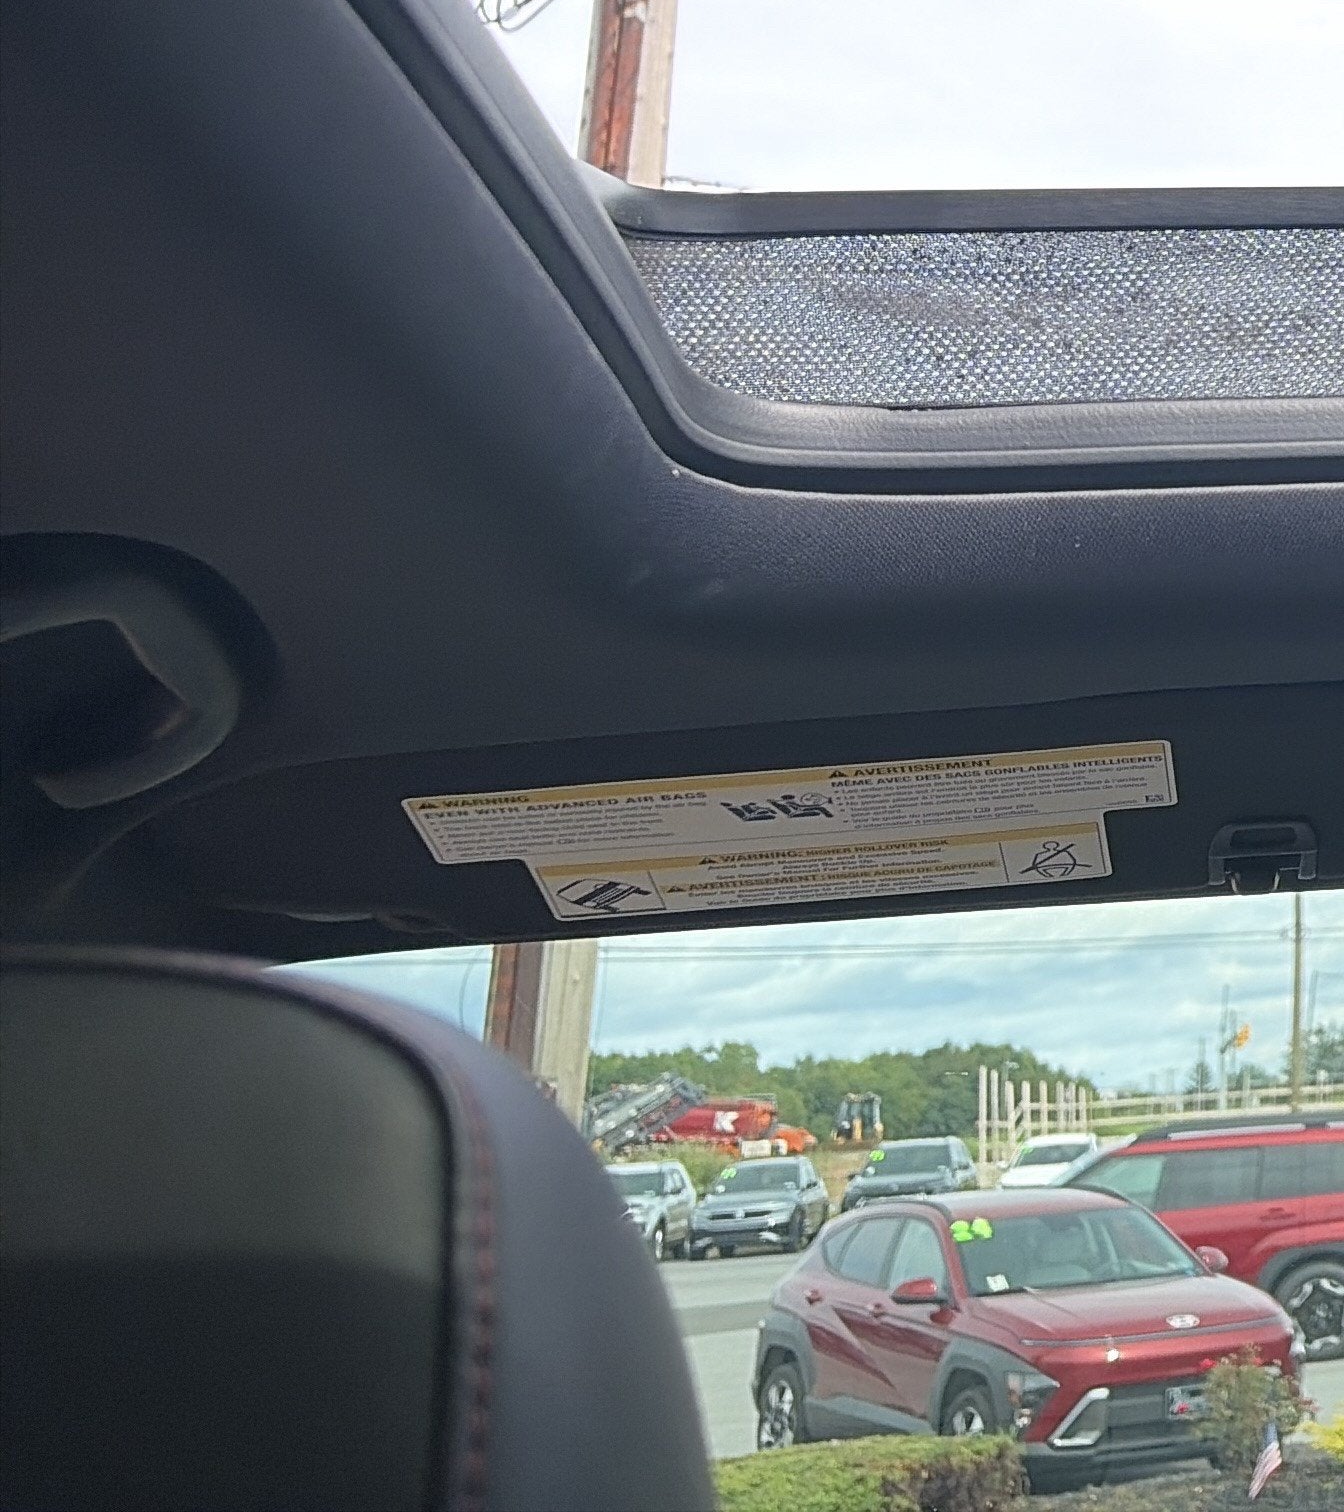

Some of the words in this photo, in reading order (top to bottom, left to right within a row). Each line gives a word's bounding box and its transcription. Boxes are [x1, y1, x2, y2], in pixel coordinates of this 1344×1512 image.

[831, 777, 873, 788] MÊME
[877, 775, 912, 785] AVEC
[916, 773, 941, 782] DES
[945, 769, 981, 779] SACS
[984, 763, 1069, 776] GONFLABLES
[1073, 754, 1162, 768] INTELLIGENTS
[854, 759, 991, 777] AVERTISSEMENT
[425, 810, 469, 820] EVEN
[475, 806, 520, 815] WITH
[526, 798, 618, 811] ADVANCED
[626, 795, 654, 804] AIR
[661, 791, 707, 801] BAGS
[442, 795, 529, 807] WARNING
[920, 839, 948, 848] RISK
